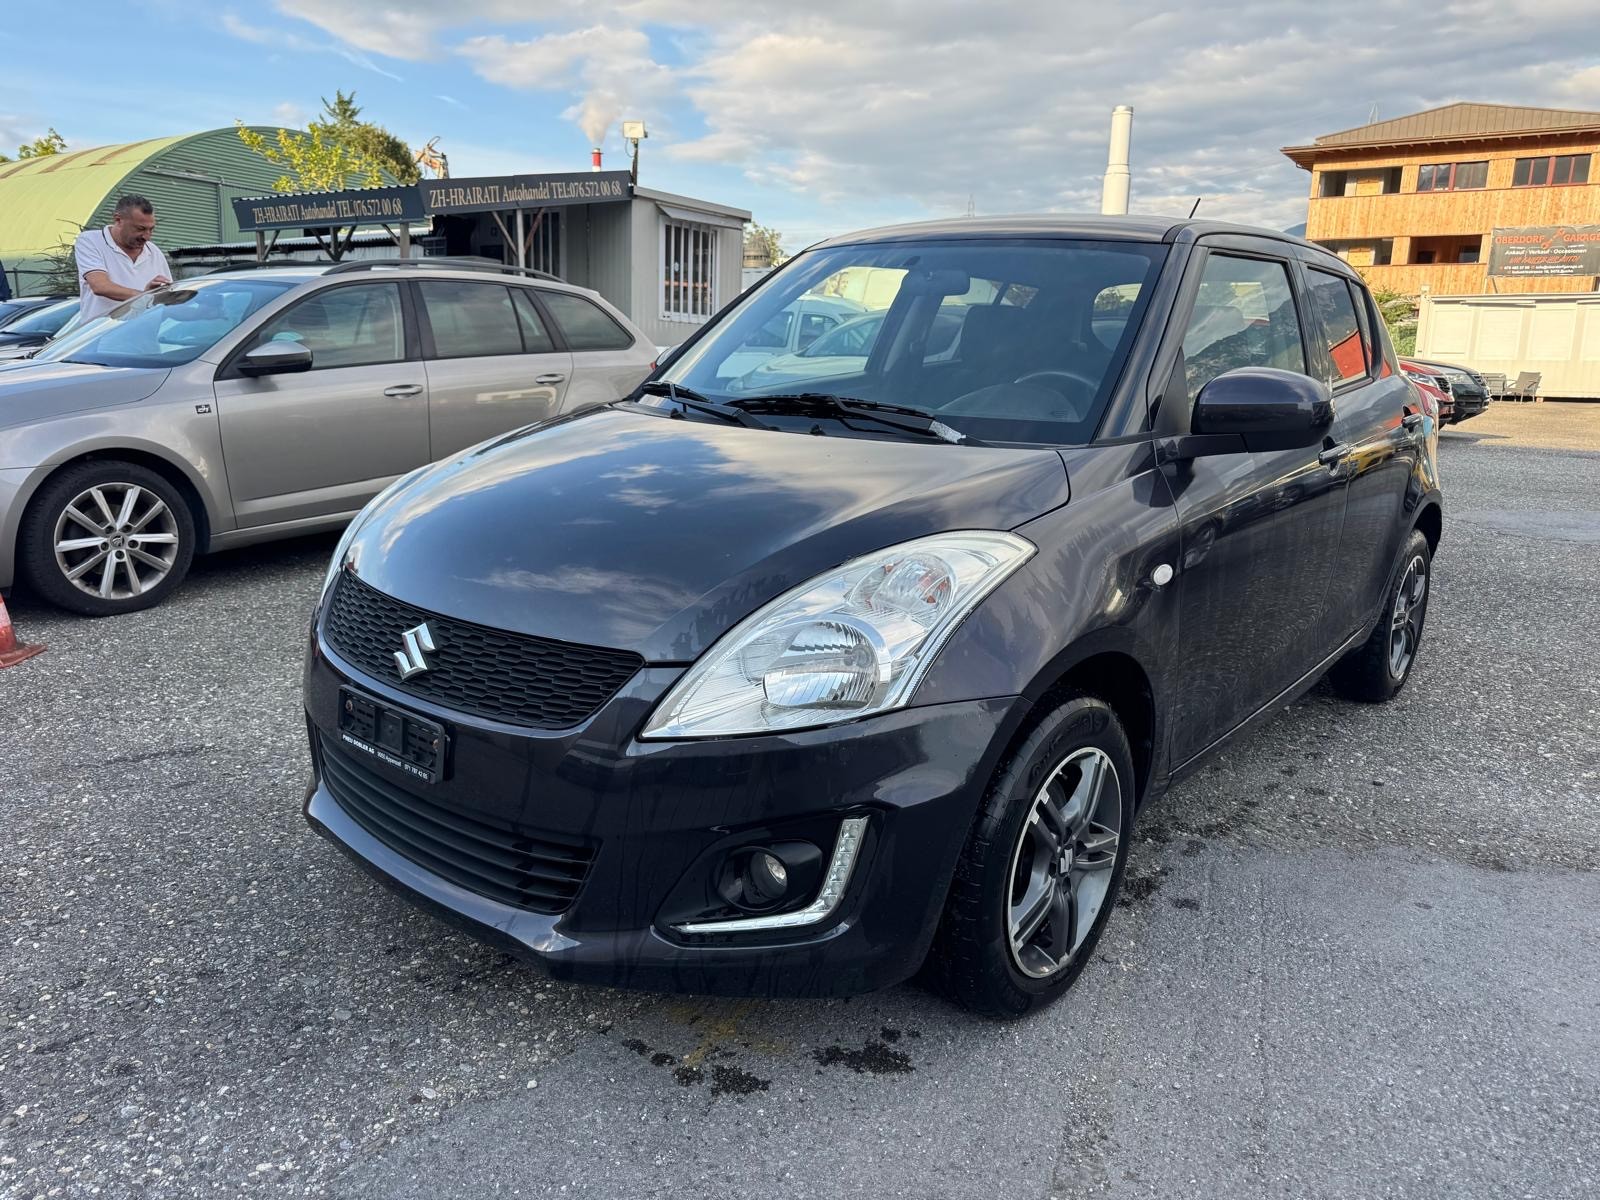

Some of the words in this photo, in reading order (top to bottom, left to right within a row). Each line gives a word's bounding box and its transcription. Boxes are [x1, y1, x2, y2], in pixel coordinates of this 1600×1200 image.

[430, 186, 500, 208] ZH-HRAIRATI
[502, 181, 550, 202] Autohandel
[600, 180, 610, 196] 00
[611, 180, 622, 196] 68
[252, 204, 300, 224] ZH-HRAIRATI
[300, 200, 337, 220] Autohandel
[381, 198, 391, 215] 00
[392, 198, 403, 215] 68
[1495, 235, 1545, 243] OBERDORF
